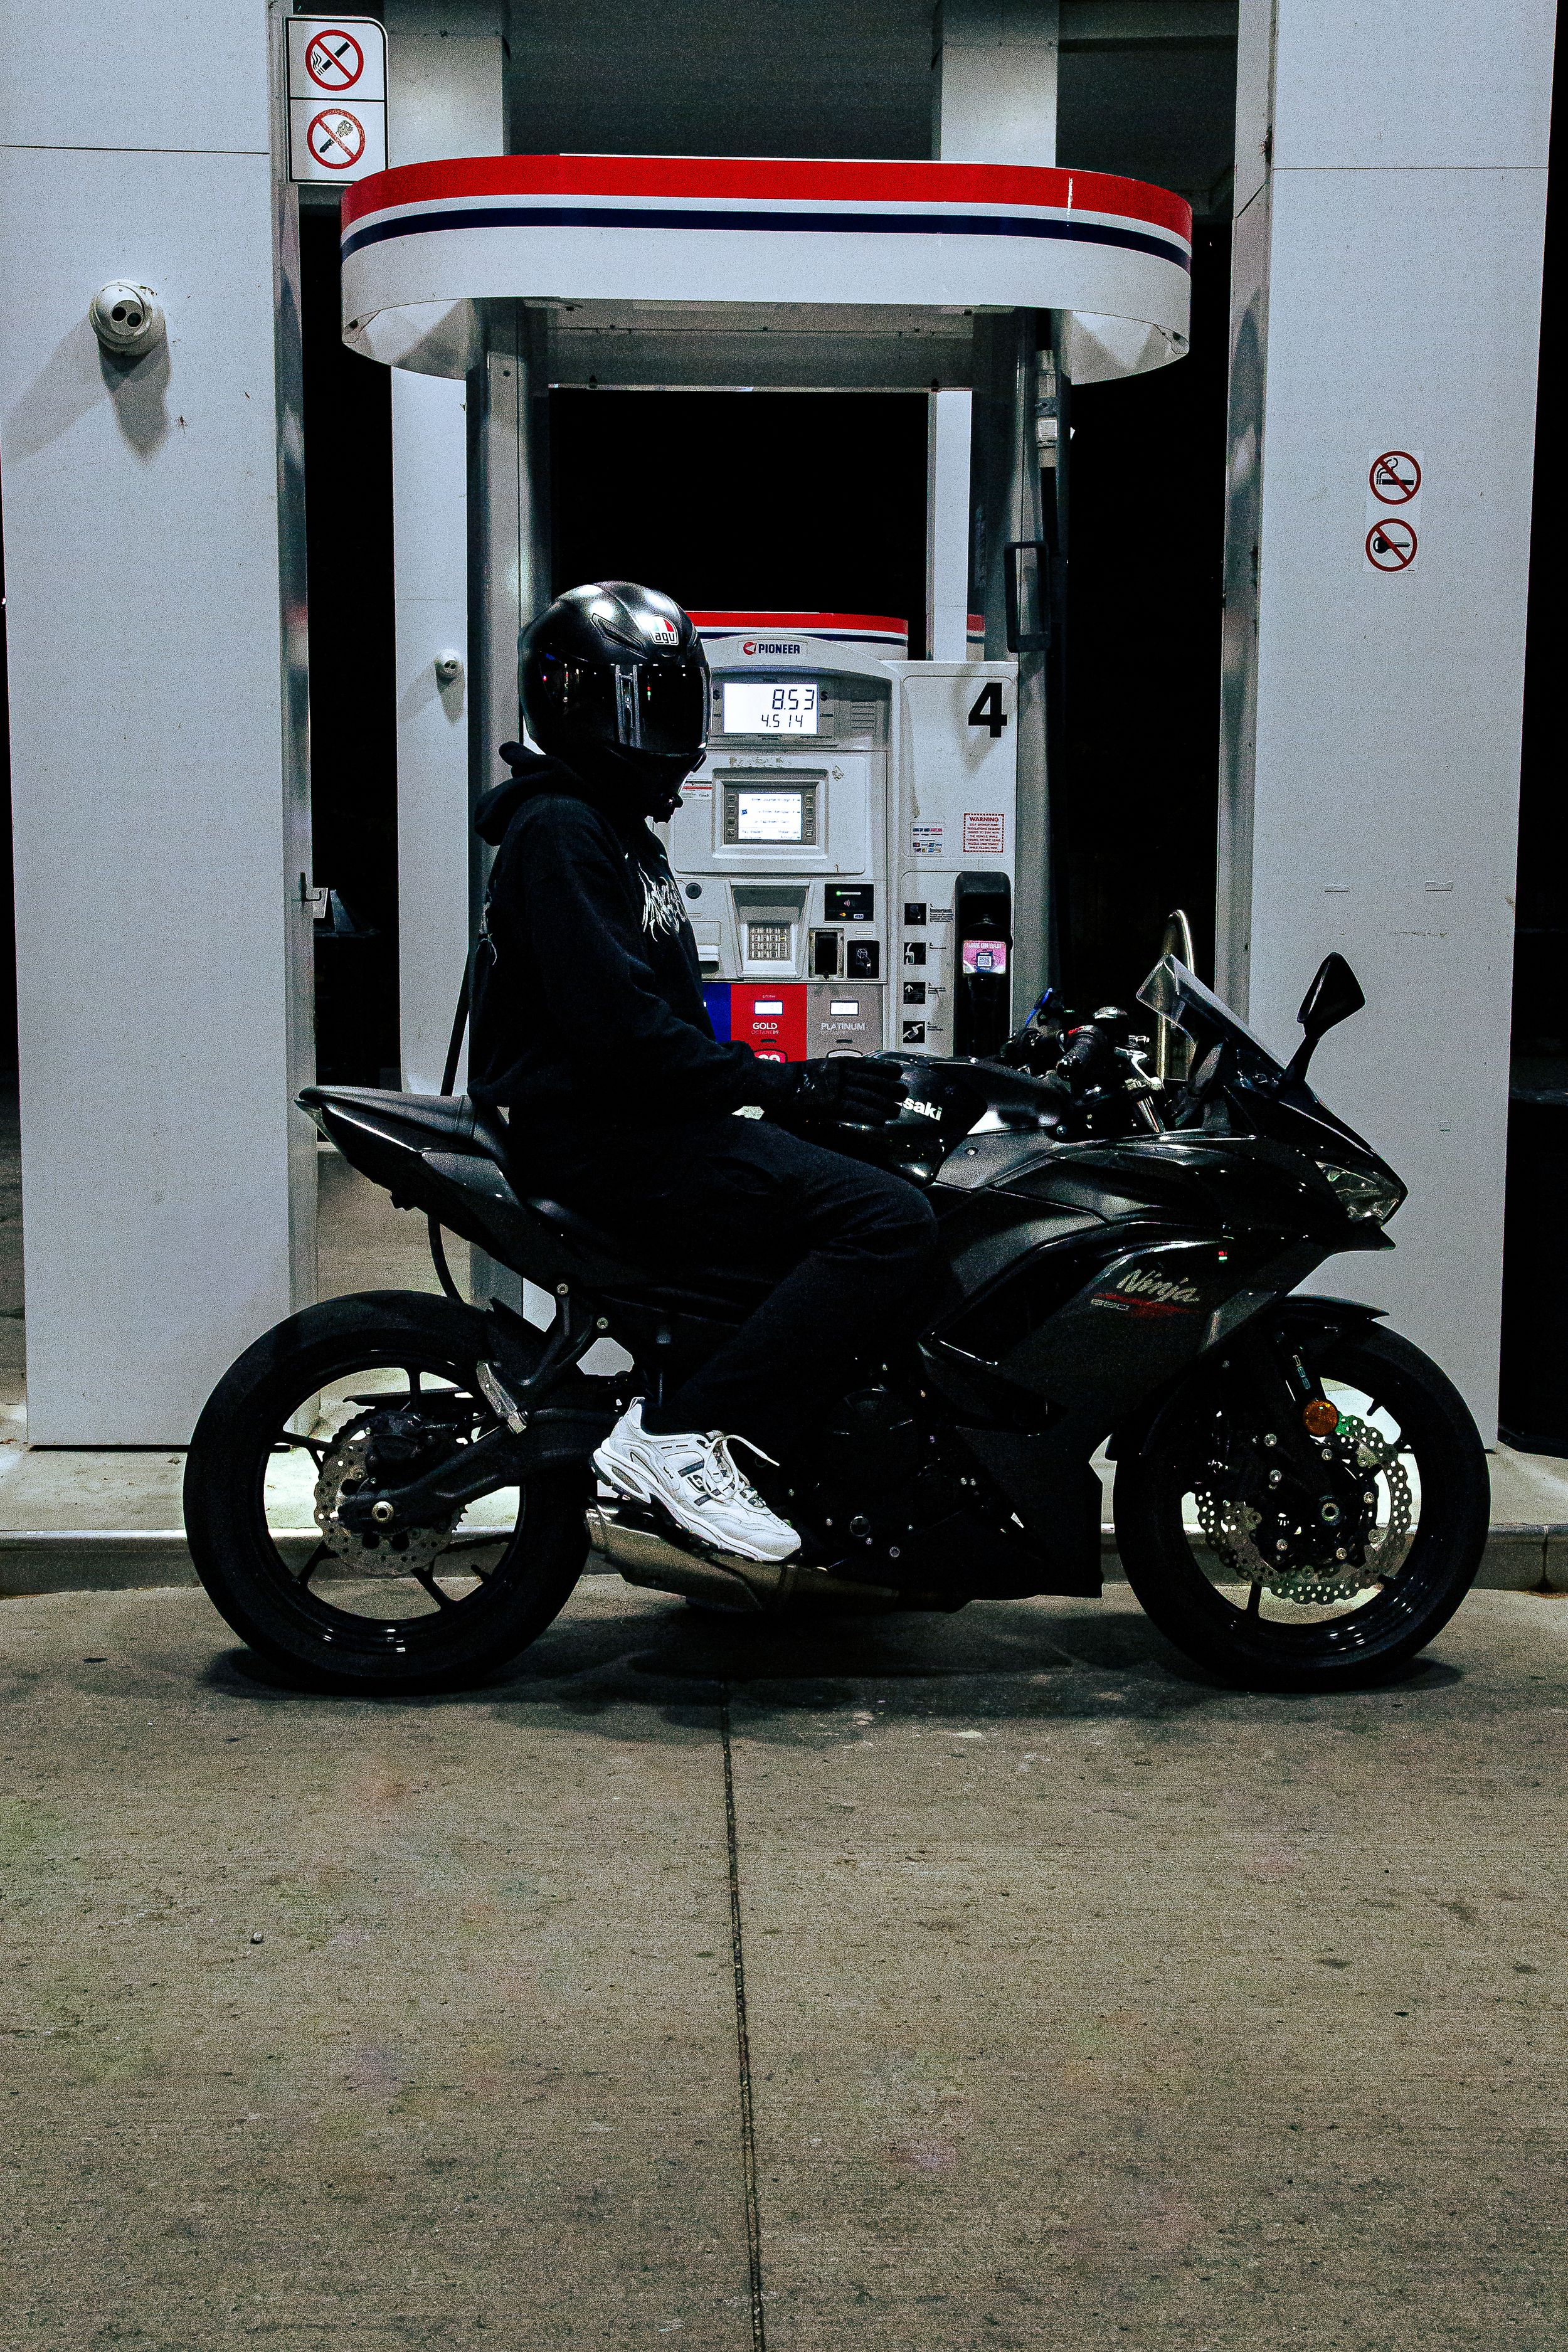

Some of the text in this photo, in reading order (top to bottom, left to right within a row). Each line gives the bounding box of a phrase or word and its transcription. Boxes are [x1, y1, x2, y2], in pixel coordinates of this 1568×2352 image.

[758, 644, 800, 654] PIONEER
[772, 689, 815, 710] 8.53
[968, 682, 1008, 738] 4
[761, 714, 803, 728] 4.514
[821, 1022, 866, 1030] PLATINUM
[895, 1098, 943, 1121] saki
[1116, 1268, 1200, 1304] Ninja
